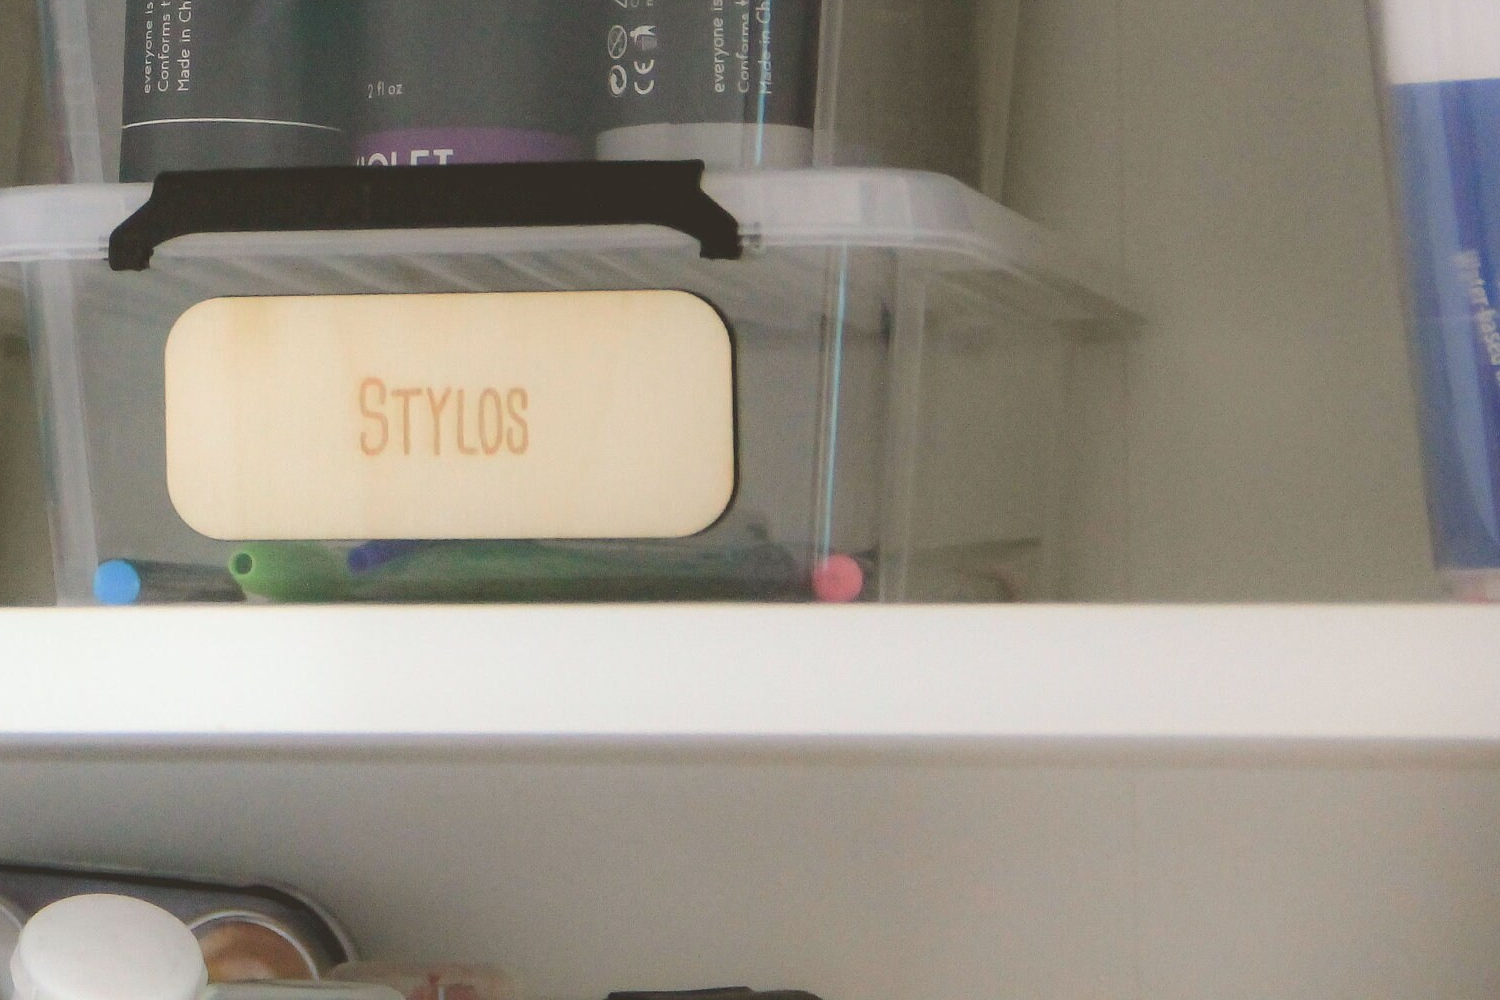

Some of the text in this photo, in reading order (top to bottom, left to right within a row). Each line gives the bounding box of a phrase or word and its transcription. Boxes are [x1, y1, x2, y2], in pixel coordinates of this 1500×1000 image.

[145, 2, 154, 14] is
[180, 31, 191, 42] in
[144, 20, 156, 94] everyone
[158, 14, 171, 93] Conforms
[177, 49, 190, 92] Made
[388, 83, 403, 96] oz
[714, 17, 730, 93] everyone
[735, 12, 749, 94] Conforms
[359, 377, 530, 457] STYLOS
